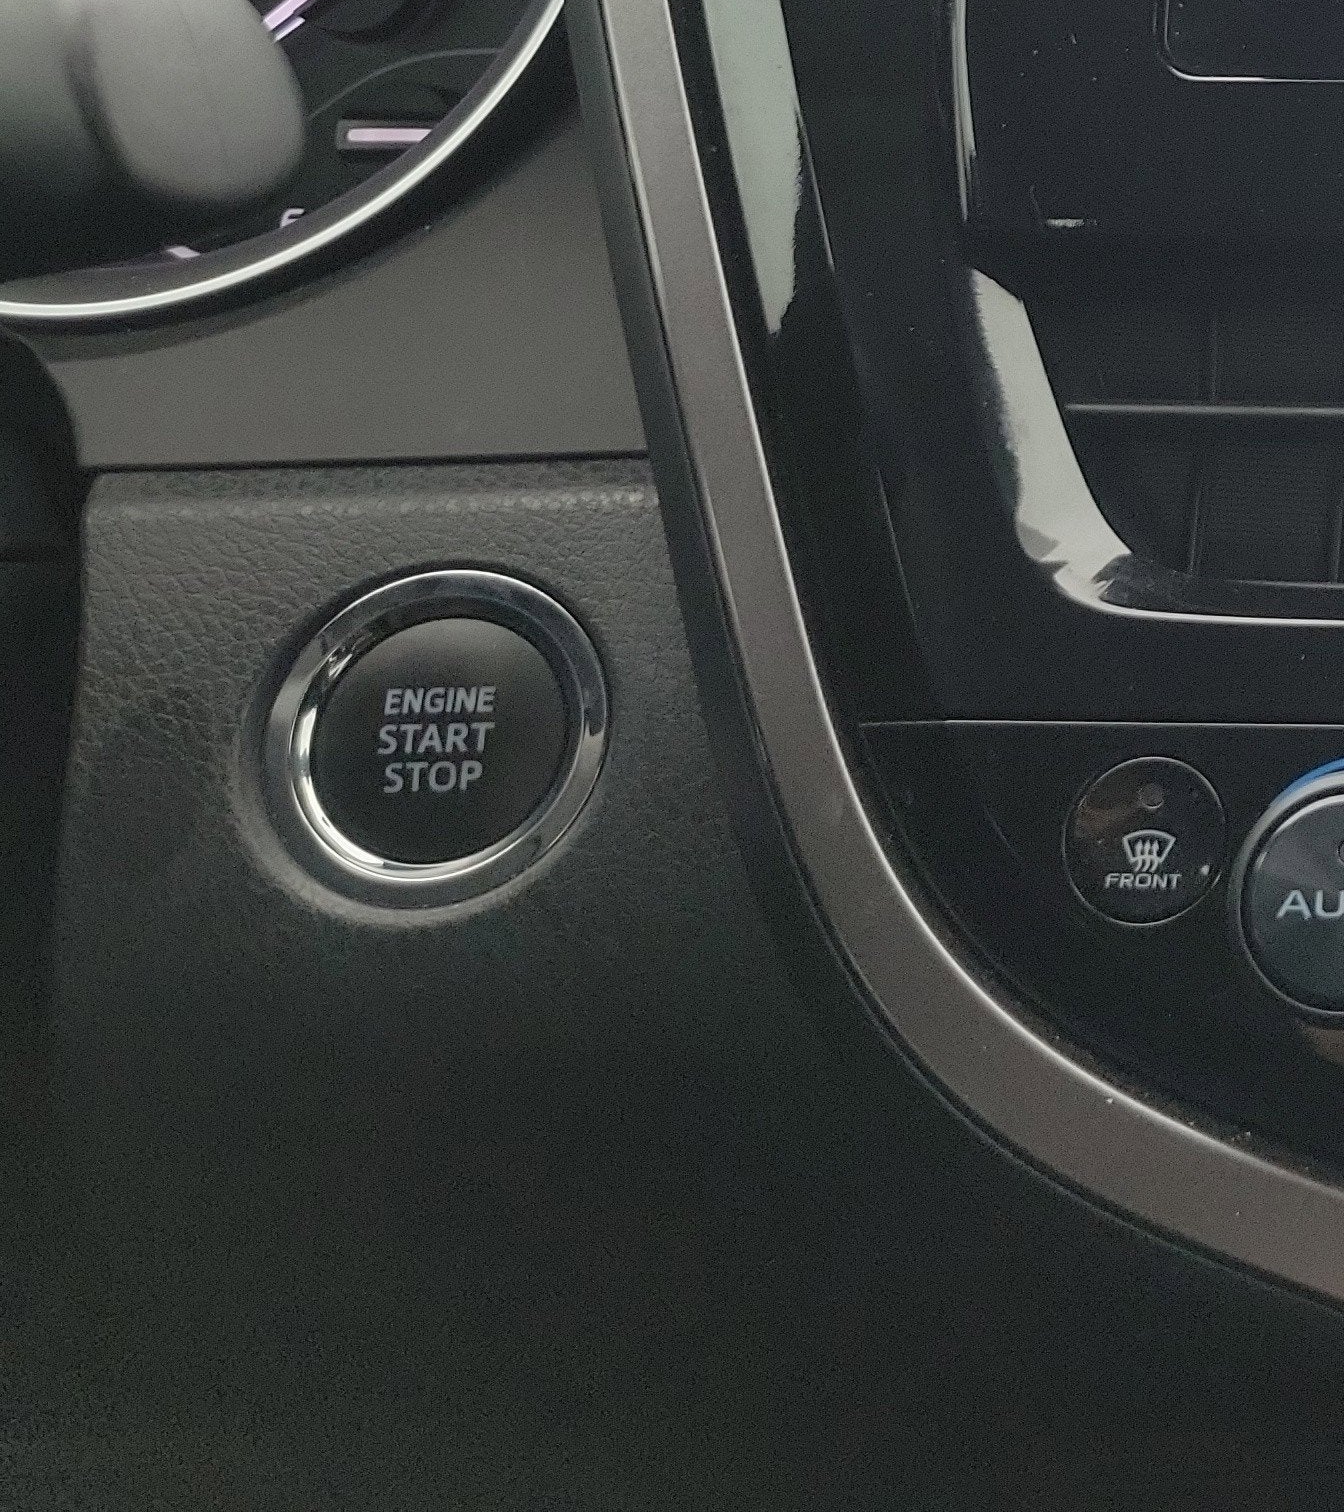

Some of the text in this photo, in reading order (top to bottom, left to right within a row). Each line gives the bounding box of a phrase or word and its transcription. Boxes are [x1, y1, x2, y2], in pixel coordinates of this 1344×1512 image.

[384, 686, 496, 716] ENGINE
[378, 721, 495, 755] START
[383, 760, 482, 794] STOP
[1104, 871, 1182, 891] FRONT
